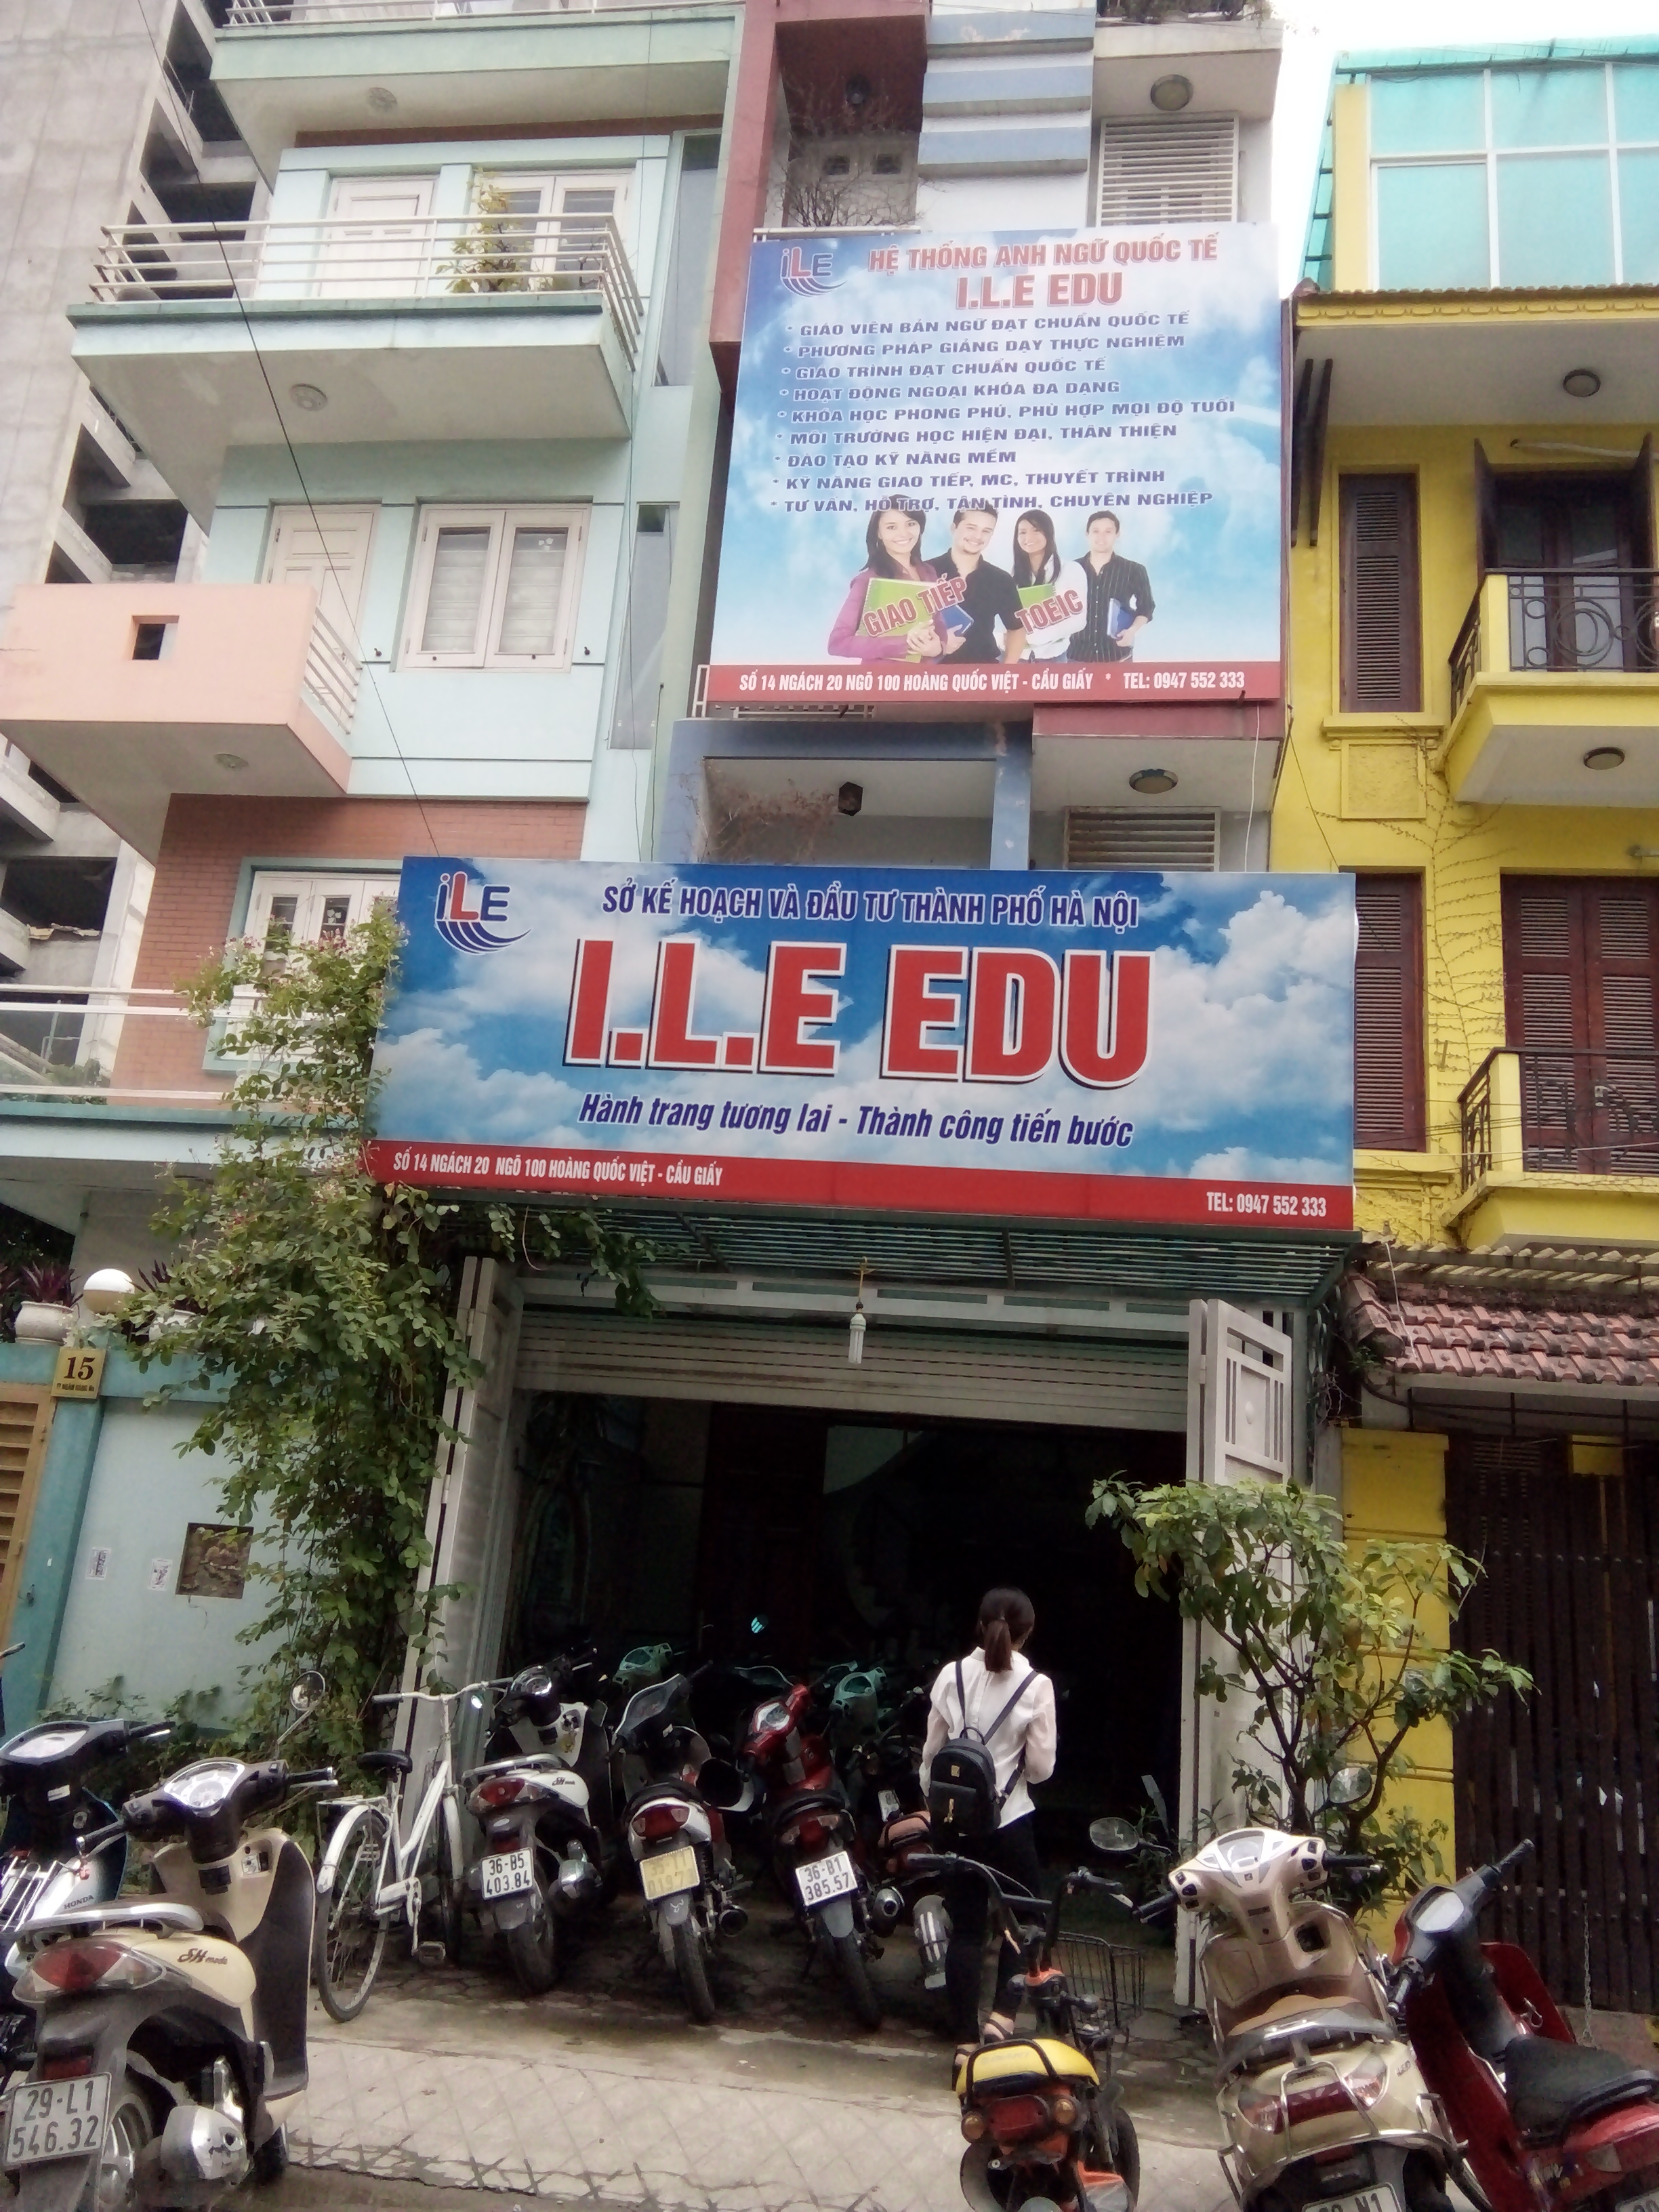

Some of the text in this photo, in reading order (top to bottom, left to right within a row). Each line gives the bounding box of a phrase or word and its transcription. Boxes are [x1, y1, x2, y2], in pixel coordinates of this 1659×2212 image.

[869, 231, 1221, 276] HỆ THỐNG ANH NGỮ QUỐC TẾ
[956, 272, 1122, 310] I.L.E EDU
[800, 323, 844, 336] GIÁO
[851, 321, 893, 335] VIÊN
[899, 319, 939, 333] BẢN
[945, 319, 987, 332] NGỮ
[991, 319, 1028, 332] ĐẠT
[1108, 311, 1160, 327] QUỐC
[1167, 310, 1191, 325] TẾ
[798, 333, 1185, 357] PHƯƠNG PHÁP GIẢNG DẠY THỰC NGHIỆM
[847, 364, 903, 377] TRÌNH
[909, 364, 945, 377] ĐẠT
[1025, 356, 1077, 373] QUỐC
[1084, 356, 1107, 371] TẾ
[794, 381, 1120, 403] HOẠT ĐỘNG NGOẠI KHÓA ĐA DẠNG
[792, 408, 843, 423] KHÓA
[849, 409, 888, 424] HỌC
[894, 407, 960, 421] PHONG
[967, 404, 1012, 419] PHÚ,
[1019, 403, 1059, 417] PHÙ
[1065, 403, 1104, 418] HỢP
[1111, 403, 1150, 417] MỌI
[1157, 400, 1183, 415] ĐỘ
[790, 423, 1176, 445] MÔI TRƯỜNG HỌC HIỆN ĐẠI, THÂN THIỆN
[787, 453, 826, 468] ĐÀO
[833, 453, 869, 469] TẠO
[875, 451, 900, 466] KỸ
[906, 451, 960, 465] NĂNG
[786, 468, 1165, 489] KỸ NĂNG GIAO TIẾP, MC, THUYẾT TRÌNH
[785, 499, 810, 512] TƯ
[814, 496, 858, 512] VẤN,
[897, 497, 940, 512] TRỢ,
[991, 494, 1043, 509] TÌNH,
[1050, 492, 1130, 508] CHUYÊN
[1136, 491, 1213, 507] NGHIỆP
[862, 573, 967, 638] GIAO TIẾP
[1015, 589, 1084, 635] TOEIC
[739, 669, 758, 691] SỐ
[761, 674, 776, 691] 14
[779, 672, 823, 691] NGÁCH
[826, 674, 841, 691] 20
[846, 671, 873, 691] NGÕ
[877, 674, 901, 691] 100
[903, 671, 949, 691] HOÀNG
[951, 668, 987, 692] QUỐC
[991, 670, 1019, 693] VIỆT
[1062, 667, 1094, 690] GIẤY
[1123, 671, 1245, 689] TEL: 0947 552 333
[602, 876, 1139, 935] SỞ KẾ HOẠCH VÀ ĐẦU TƯ THÀNH PHỐ HÀ NỘI
[562, 937, 1156, 1091] I.L.E EDU
[578, 1092, 644, 1125] Hành
[648, 1097, 716, 1131] trang
[719, 1101, 792, 1134] tương
[796, 1103, 833, 1133] lai
[857, 1105, 933, 1138] Thành
[939, 1109, 1004, 1145] công
[1010, 1108, 1061, 1143] tiến
[1067, 1115, 1134, 1147] bước
[393, 1148, 412, 1172] SỐ
[413, 1153, 428, 1172] 14
[430, 1151, 472, 1174] NGÁCH
[474, 1155, 489, 1175] 20
[495, 1153, 521, 1176] NGÕ
[525, 1159, 546, 1179] 100
[548, 1158, 590, 1181] HOÀNG
[593, 1155, 626, 1182] QUỐC
[629, 1160, 655, 1187] VIỆT
[694, 1160, 723, 1186] GIẤY
[1206, 1191, 1327, 1217] TEL: 0947 552 333
[64, 1356, 96, 1380] 15
[489, 1853, 525, 1876] 36-B5
[804, 1857, 842, 1883] 36-B1
[486, 1870, 530, 1896] 403.84
[805, 1872, 849, 1901] 385.57
[64, 1894, 94, 1910] HONDA
[24, 2080, 94, 2121] 29-L1
[12, 2115, 99, 2158] 546.32
